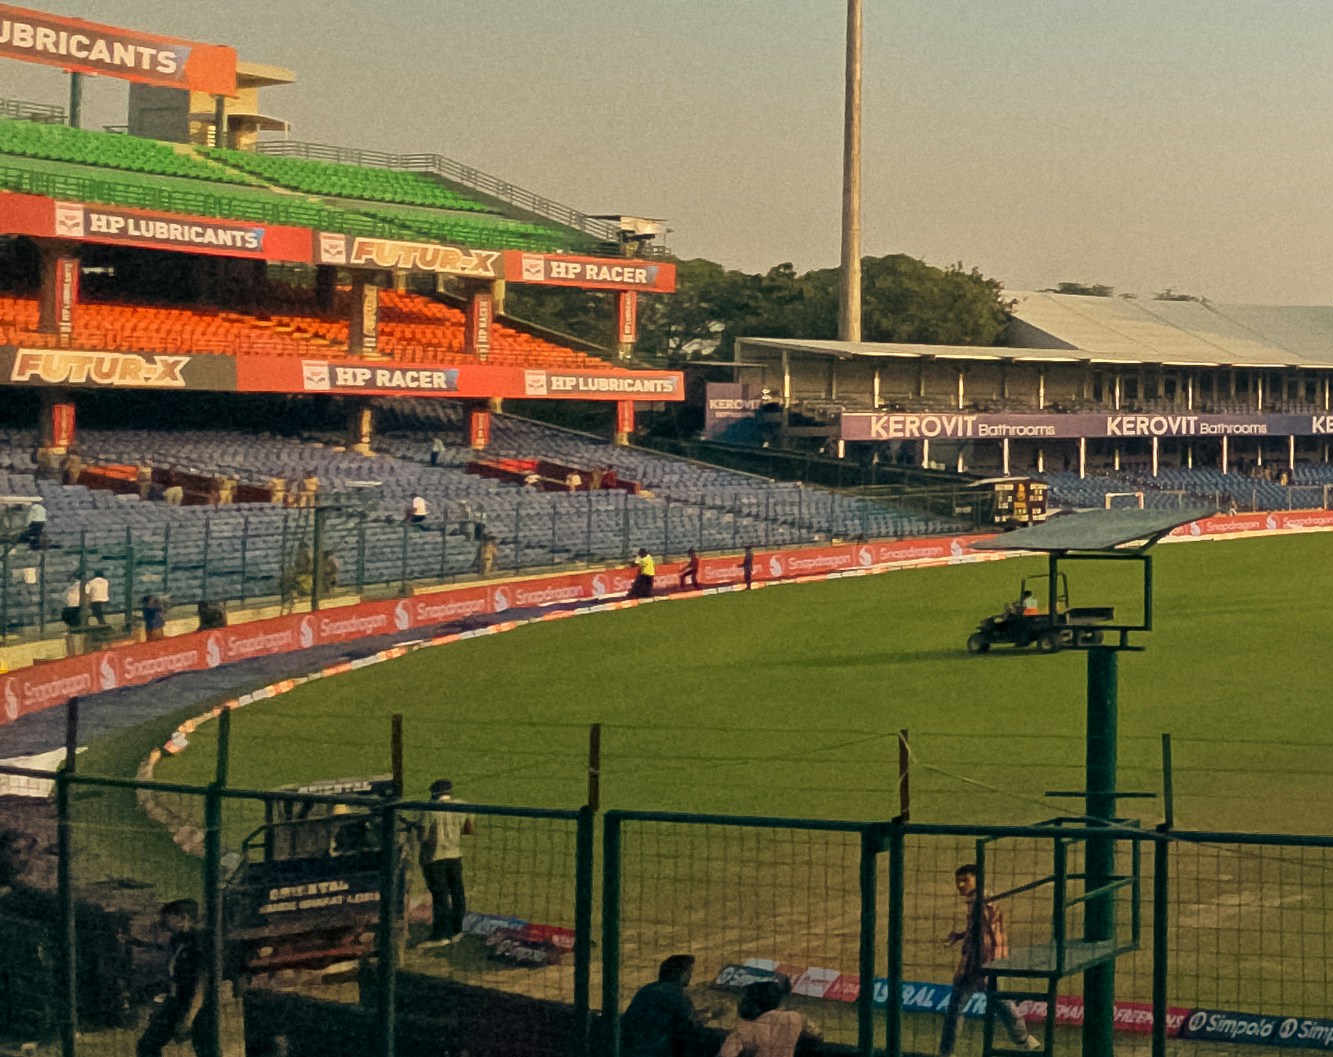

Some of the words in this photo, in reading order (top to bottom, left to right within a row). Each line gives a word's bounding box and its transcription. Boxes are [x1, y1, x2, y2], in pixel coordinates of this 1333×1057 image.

[90, 213, 126, 234] HP
[127, 218, 258, 249] LUBRICANTS
[350, 237, 498, 277] FUTUR-X
[550, 261, 581, 279] HP
[584, 264, 647, 284] RACER
[11, 348, 191, 387] FUTUR-X
[336, 367, 371, 386] HP
[375, 369, 447, 389] RACER
[551, 377, 576, 392] HP
[579, 377, 674, 393] LUBRICANTS
[709, 400, 760, 410] KEROVIT
[870, 416, 976, 438] KEROVIT
[978, 423, 1055, 437] Bathrooms
[1107, 416, 1198, 436] KEROVIT
[1200, 423, 1267, 435] Bathrooms
[789, 555, 851, 571] Snapdragon
[879, 546, 944, 560] Snapdragon
[515, 584, 583, 606] Snapdragon
[416, 598, 485, 620] Snapdragon
[320, 613, 387, 637] Snapdragon
[226, 630, 293, 656] Snapdragon
[124, 650, 198, 680] Snapdragon
[1206, 1014, 1273, 1039] Simpolo
